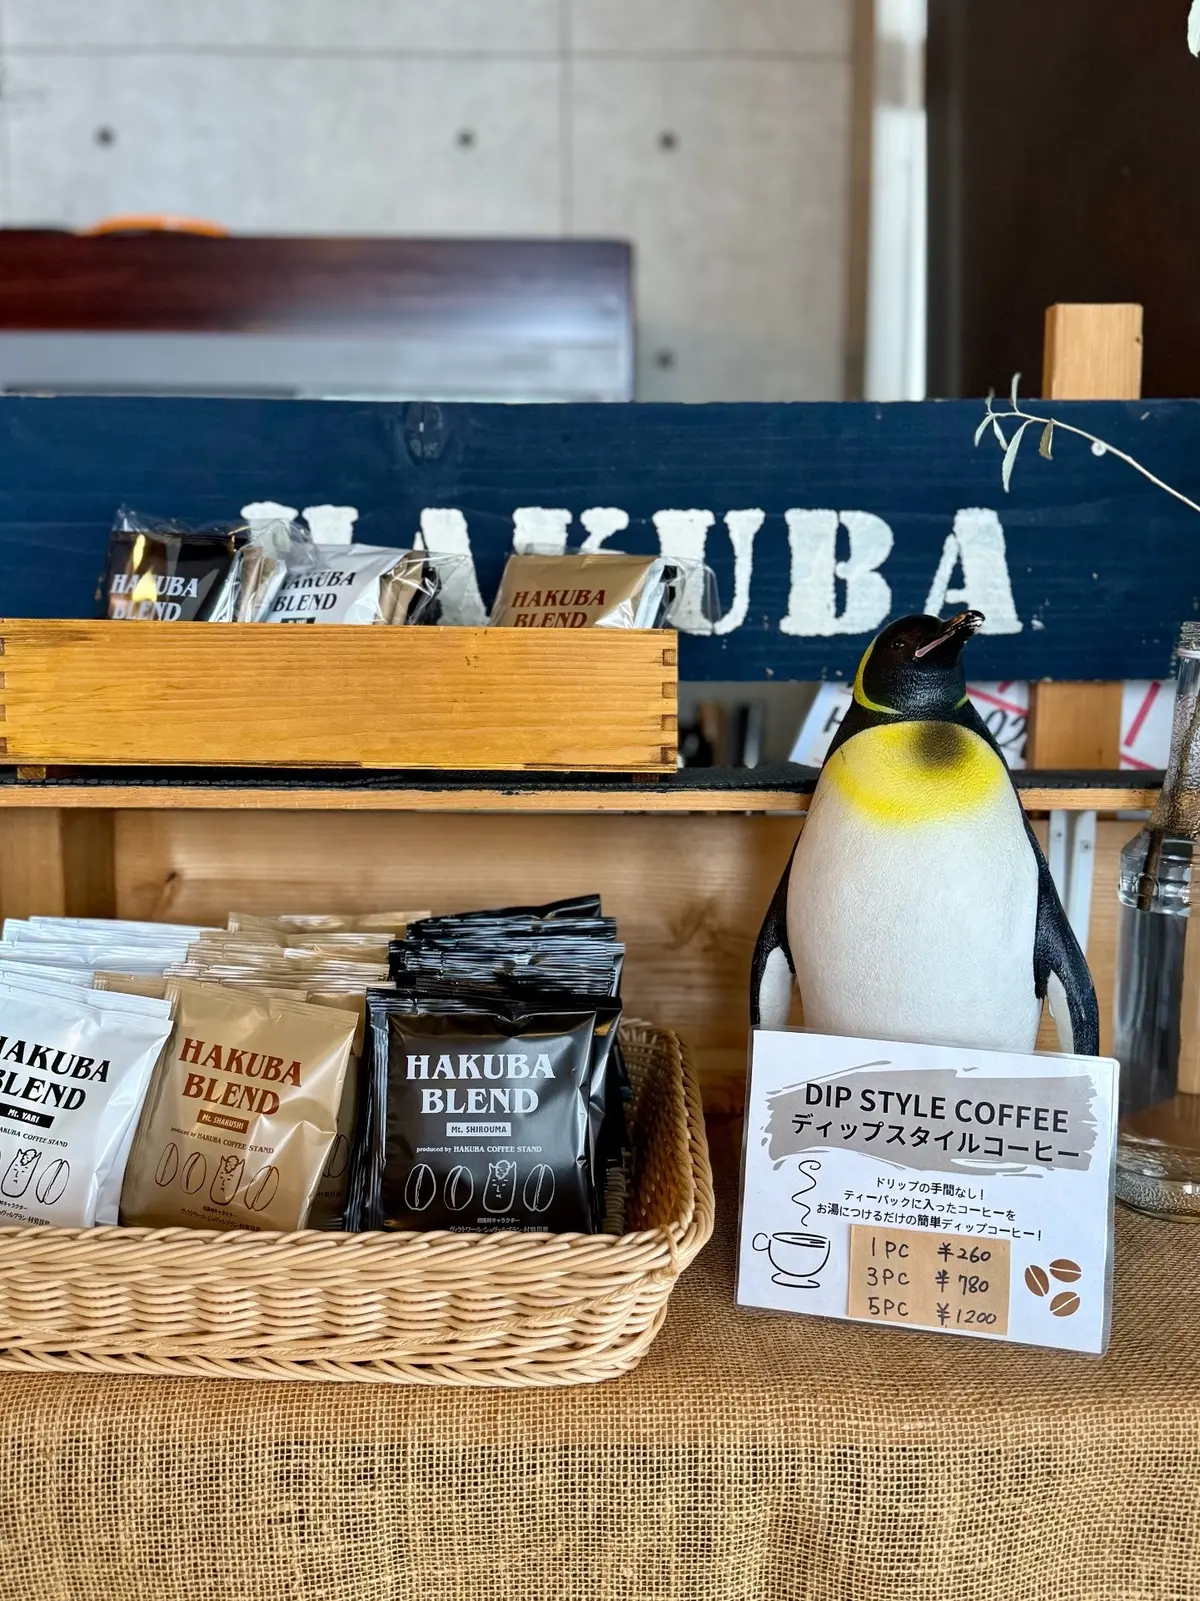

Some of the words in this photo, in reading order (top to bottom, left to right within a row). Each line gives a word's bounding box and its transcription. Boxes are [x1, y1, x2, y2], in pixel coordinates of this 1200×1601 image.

[111, 573, 199, 598] HAUBA
[273, 593, 337, 612] BLEND
[511, 589, 606, 608] HAKUBA
[513, 612, 587, 627] BLEND
[178, 1037, 302, 1088] HAKUBA
[405, 1053, 556, 1080] HAKUBA
[181, 1072, 280, 1116] BLEND
[420, 1088, 539, 1114] BLEND
[7, 1108, 20, 1118] Mt.
[21, 1112, 41, 1124] YARI
[804, 1082, 852, 1109] DIP
[859, 1088, 946, 1120] STYLE
[954, 1099, 1069, 1134] COFFEE
[201, 1113, 212, 1123] Mt.
[213, 1116, 245, 1130] SHAKUSHI
[451, 1126, 463, 1134] Mt.
[465, 1126, 507, 1134] SHIROUMA
[0, 1126, 21, 1137] AKUBA
[22, 1132, 47, 1144] COFFEE
[47, 1138, 69, 1148] STAND
[197, 1132, 222, 1145] HAKUBA
[223, 1139, 247, 1151] COFFEE
[248, 1145, 275, 1154] STAND
[791, 1112, 1080, 1162] ディップスタイルコーヒー
[416, 1145, 443, 1153] produced
[453, 1145, 485, 1153] HAKUBA
[487, 1145, 516, 1153] COFFEE
[516, 1145, 543, 1153] STAND
